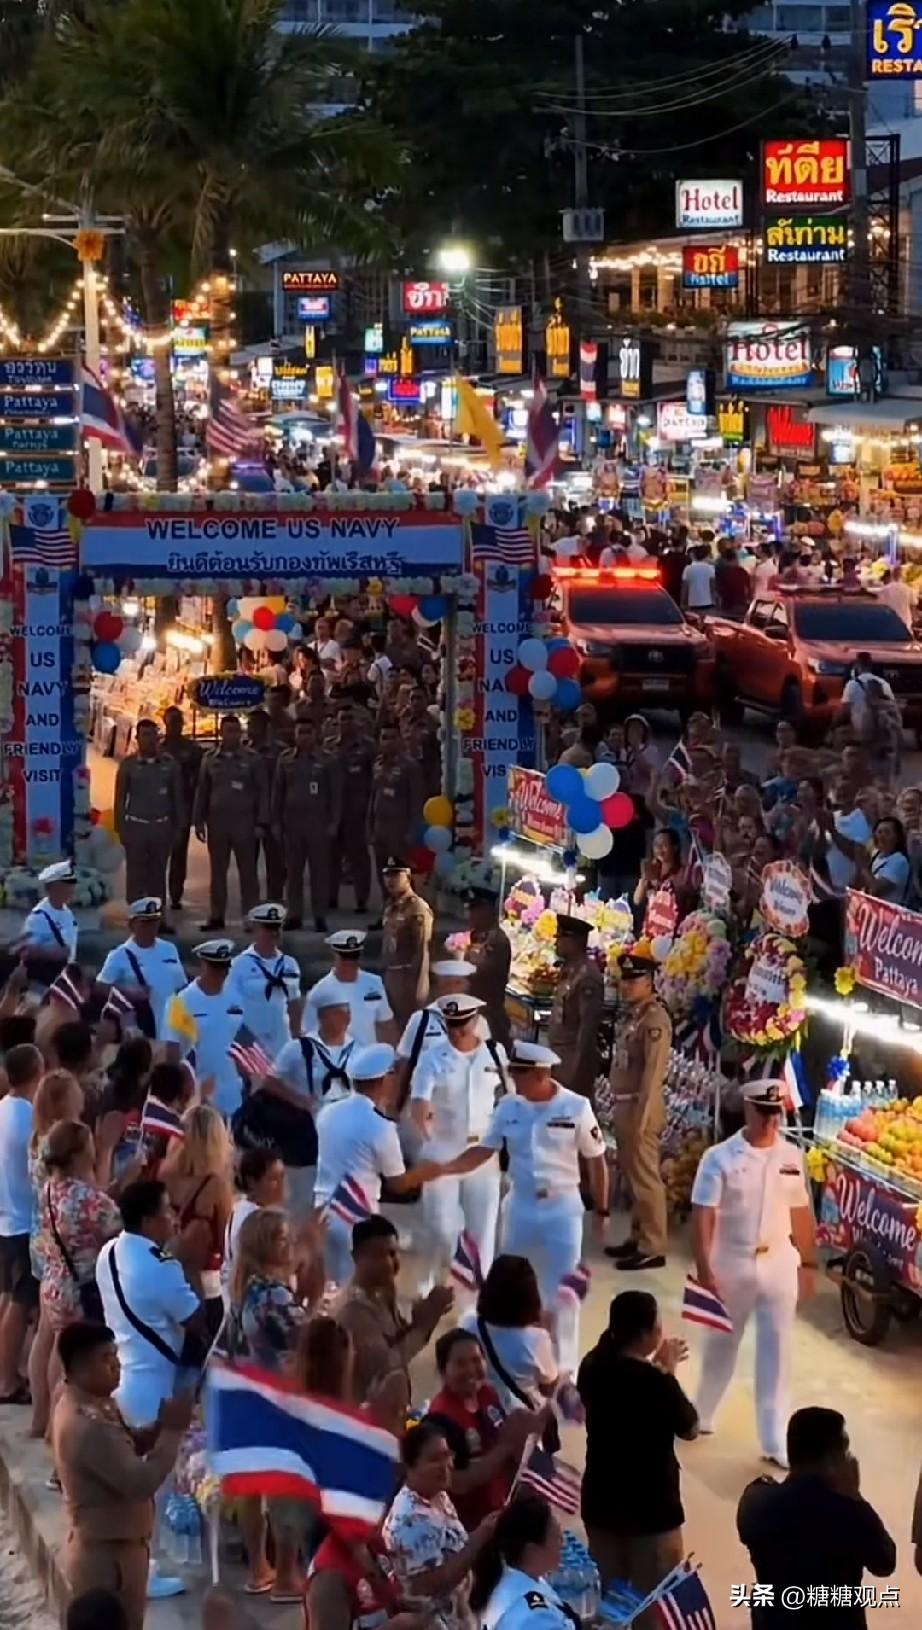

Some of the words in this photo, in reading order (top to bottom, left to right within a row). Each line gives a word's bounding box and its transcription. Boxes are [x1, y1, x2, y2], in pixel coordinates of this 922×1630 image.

[683, 186, 739, 211] Hotel
[766, 189, 844, 203] Restaurant
[767, 249, 845, 262] Restaurant
[283, 272, 337, 284] PATTAYA
[731, 335, 807, 362] Hotel
[4, 395, 58, 410] Pattaya
[4, 427, 59, 443] Pattaya
[5, 460, 59, 477] Pattaya
[148, 519, 277, 540] WELCOME
[288, 519, 321, 539] US
[331, 519, 399, 539] NAVY
[30, 652, 56, 667] US
[490, 649, 515, 665] US
[18, 681, 68, 696] NAVY
[480, 678, 506, 693] NA
[26, 713, 60, 727] AND
[485, 710, 518, 723] AND
[23, 769, 62, 782] VISIT
[482, 765, 507, 778] VIS
[874, 956, 919, 997] Pattaya
[836, 1173, 917, 1252] Welcome
